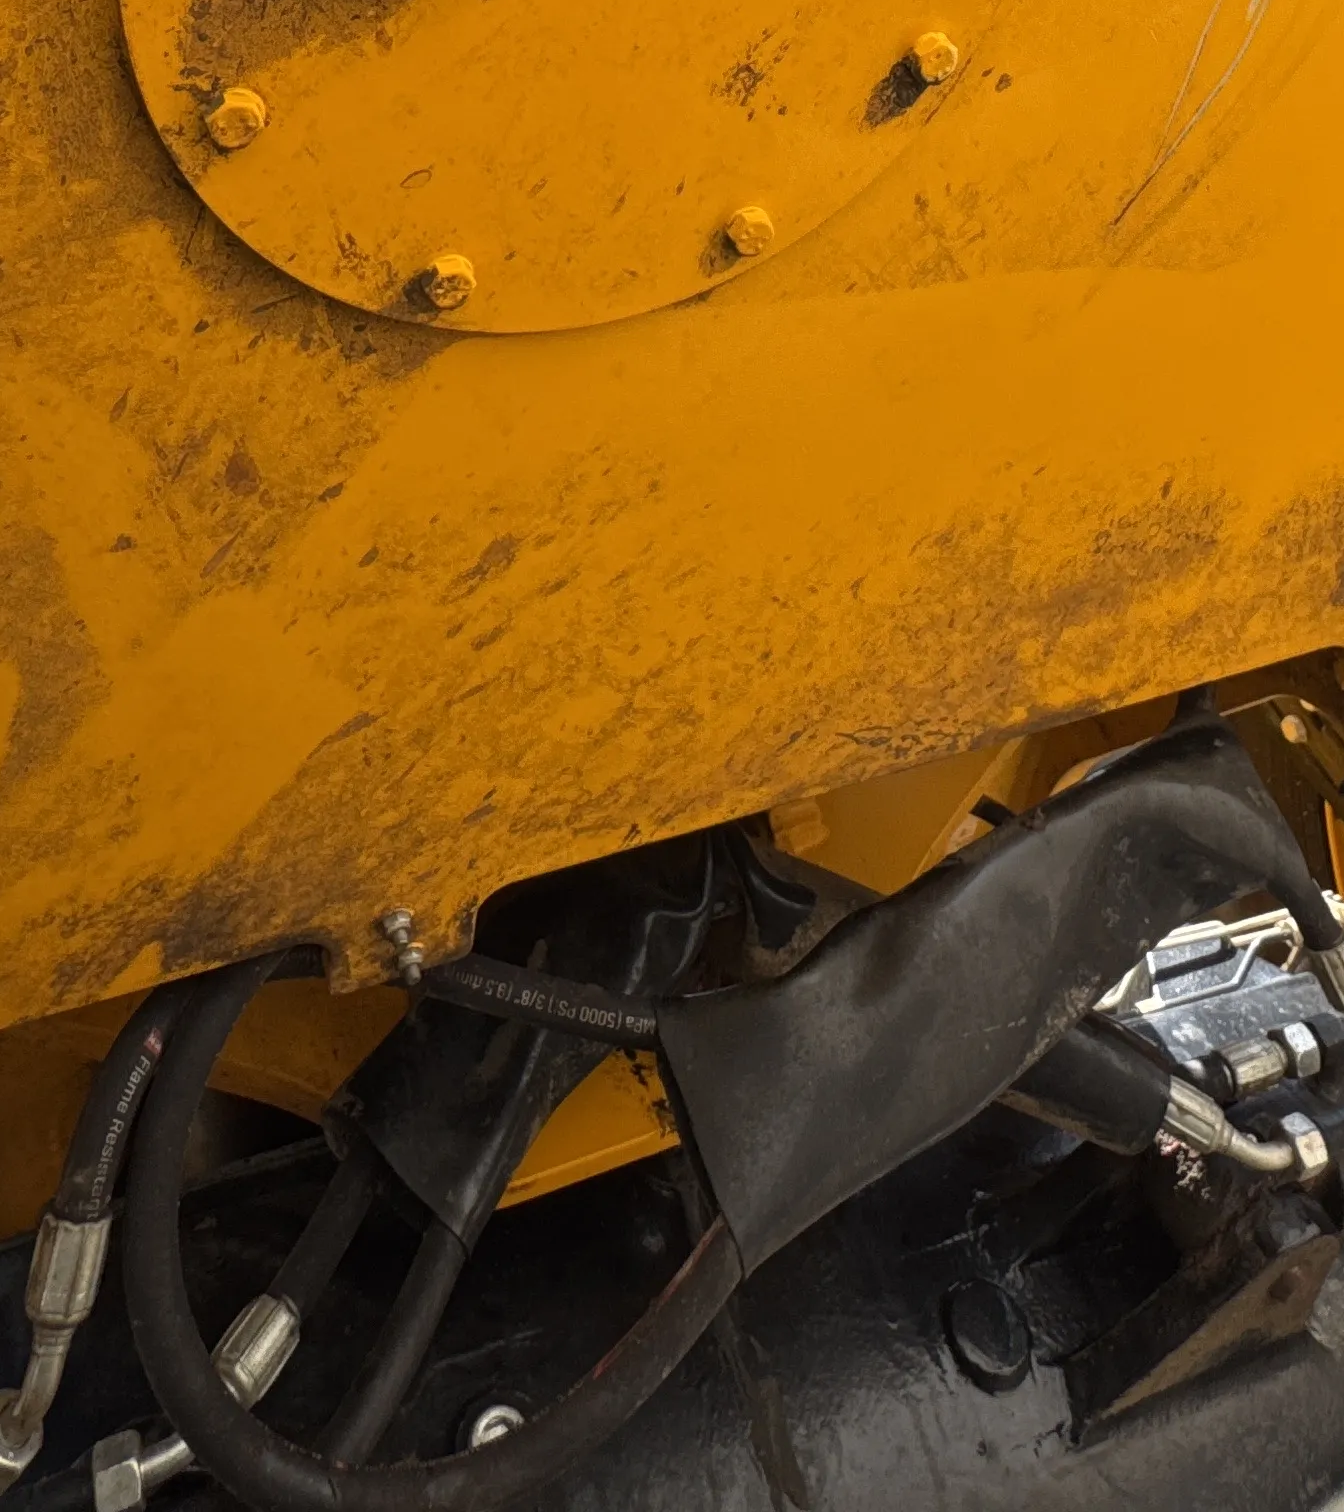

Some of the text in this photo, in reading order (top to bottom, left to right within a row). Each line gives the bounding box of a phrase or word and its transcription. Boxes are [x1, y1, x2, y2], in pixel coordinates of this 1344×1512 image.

[578, 1004, 623, 1031] (5000
[86, 1054, 151, 1220] Flame Resistant
